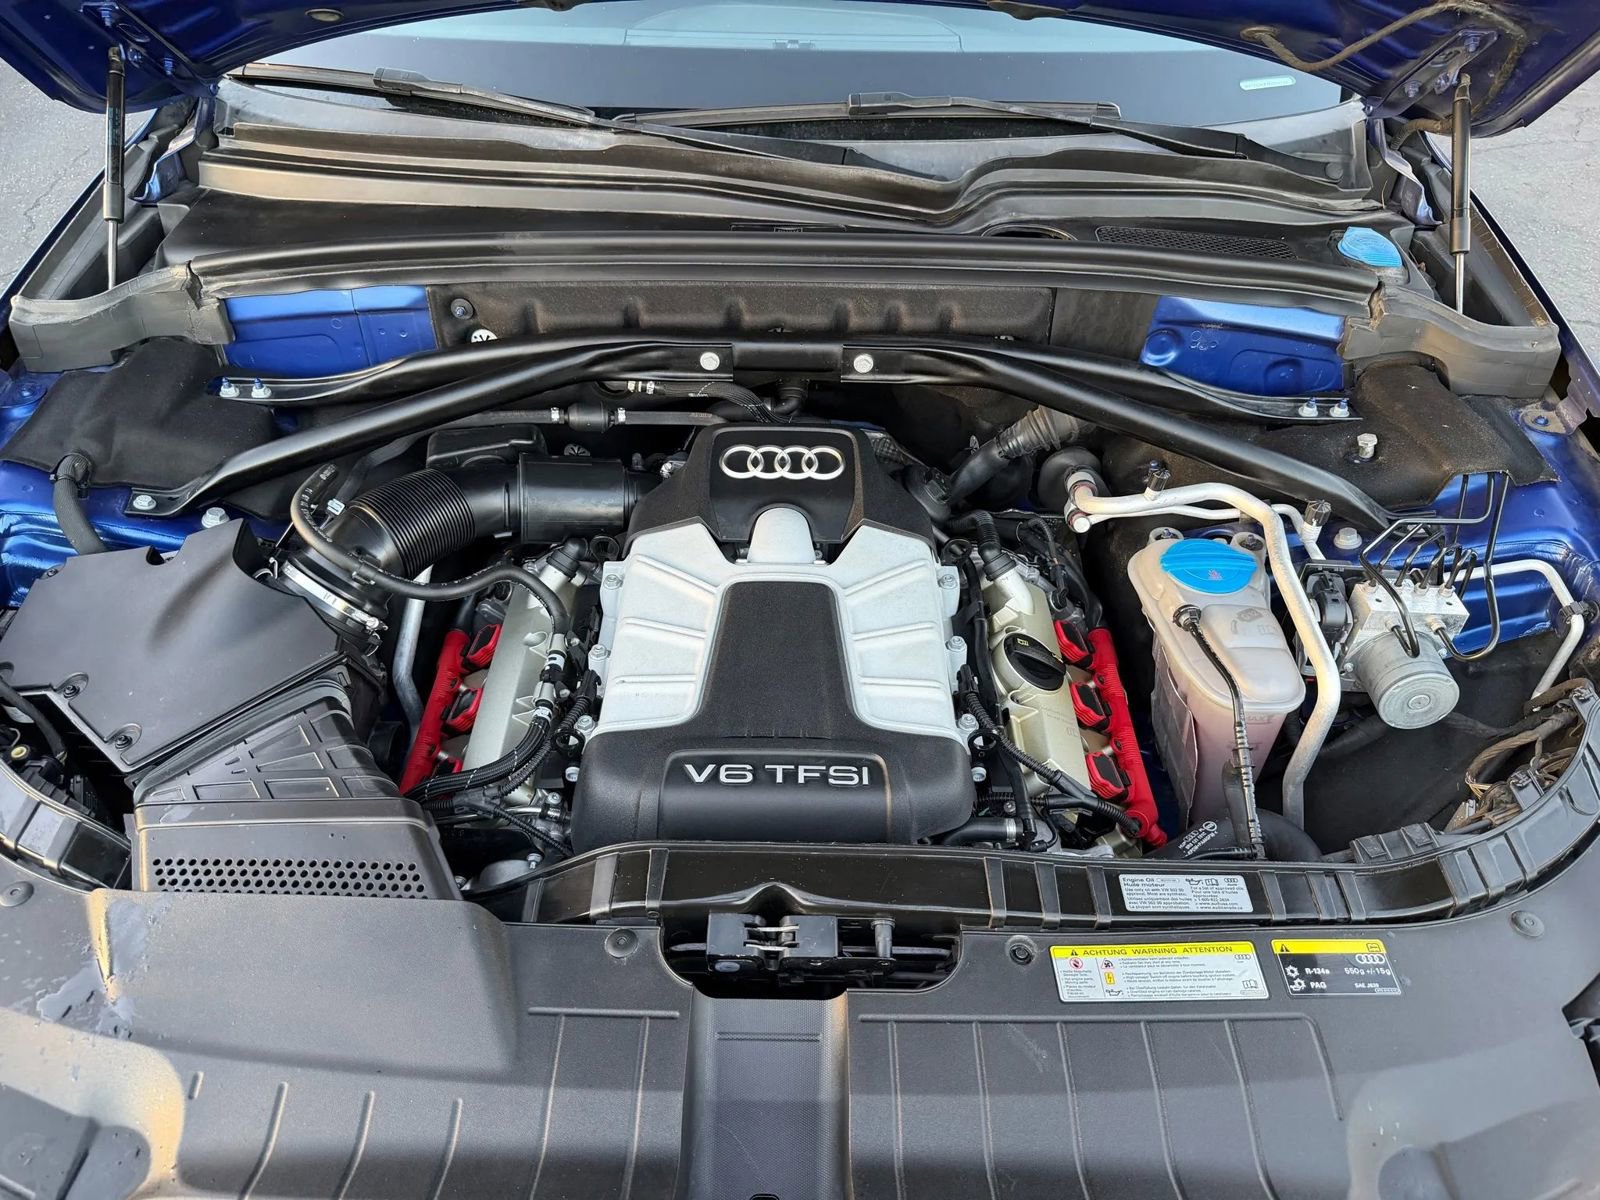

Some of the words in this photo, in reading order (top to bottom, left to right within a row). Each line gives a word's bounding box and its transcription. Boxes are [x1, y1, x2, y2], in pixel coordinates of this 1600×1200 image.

[684, 764, 753, 784] V6
[765, 764, 869, 785] TFSI
[1131, 947, 1177, 955] WARNING
[1304, 967, 1330, 975] R-134a
[1344, 967, 1365, 976] 550g
[1310, 981, 1327, 989] PAG
